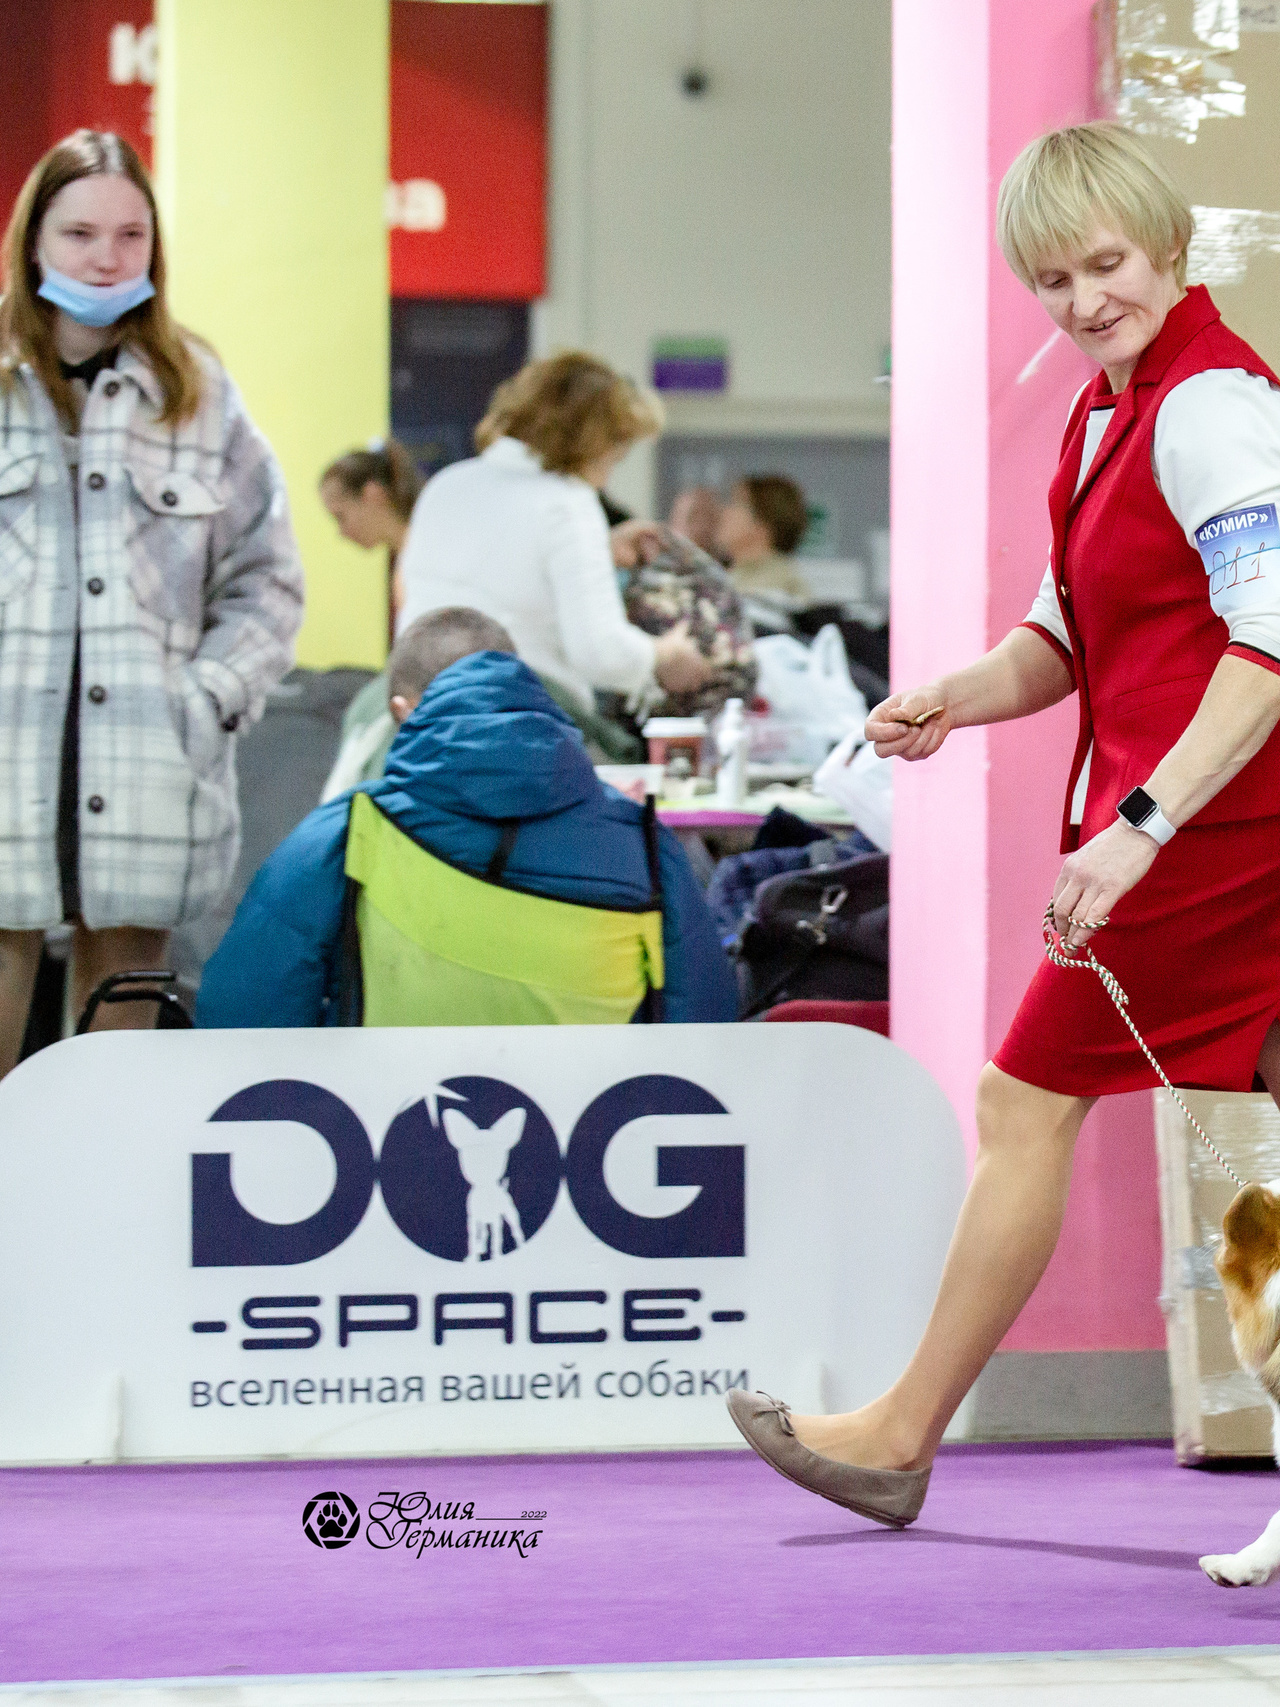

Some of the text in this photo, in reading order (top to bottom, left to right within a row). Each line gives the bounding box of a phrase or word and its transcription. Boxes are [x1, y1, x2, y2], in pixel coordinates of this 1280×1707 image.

[1199, 512, 1269, 542] «КУМИР»
[1211, 541, 1266, 596] 011
[190, 1073, 747, 1268] DOG
[190, 1359, 750, 1408] вселенная вашей собаки
